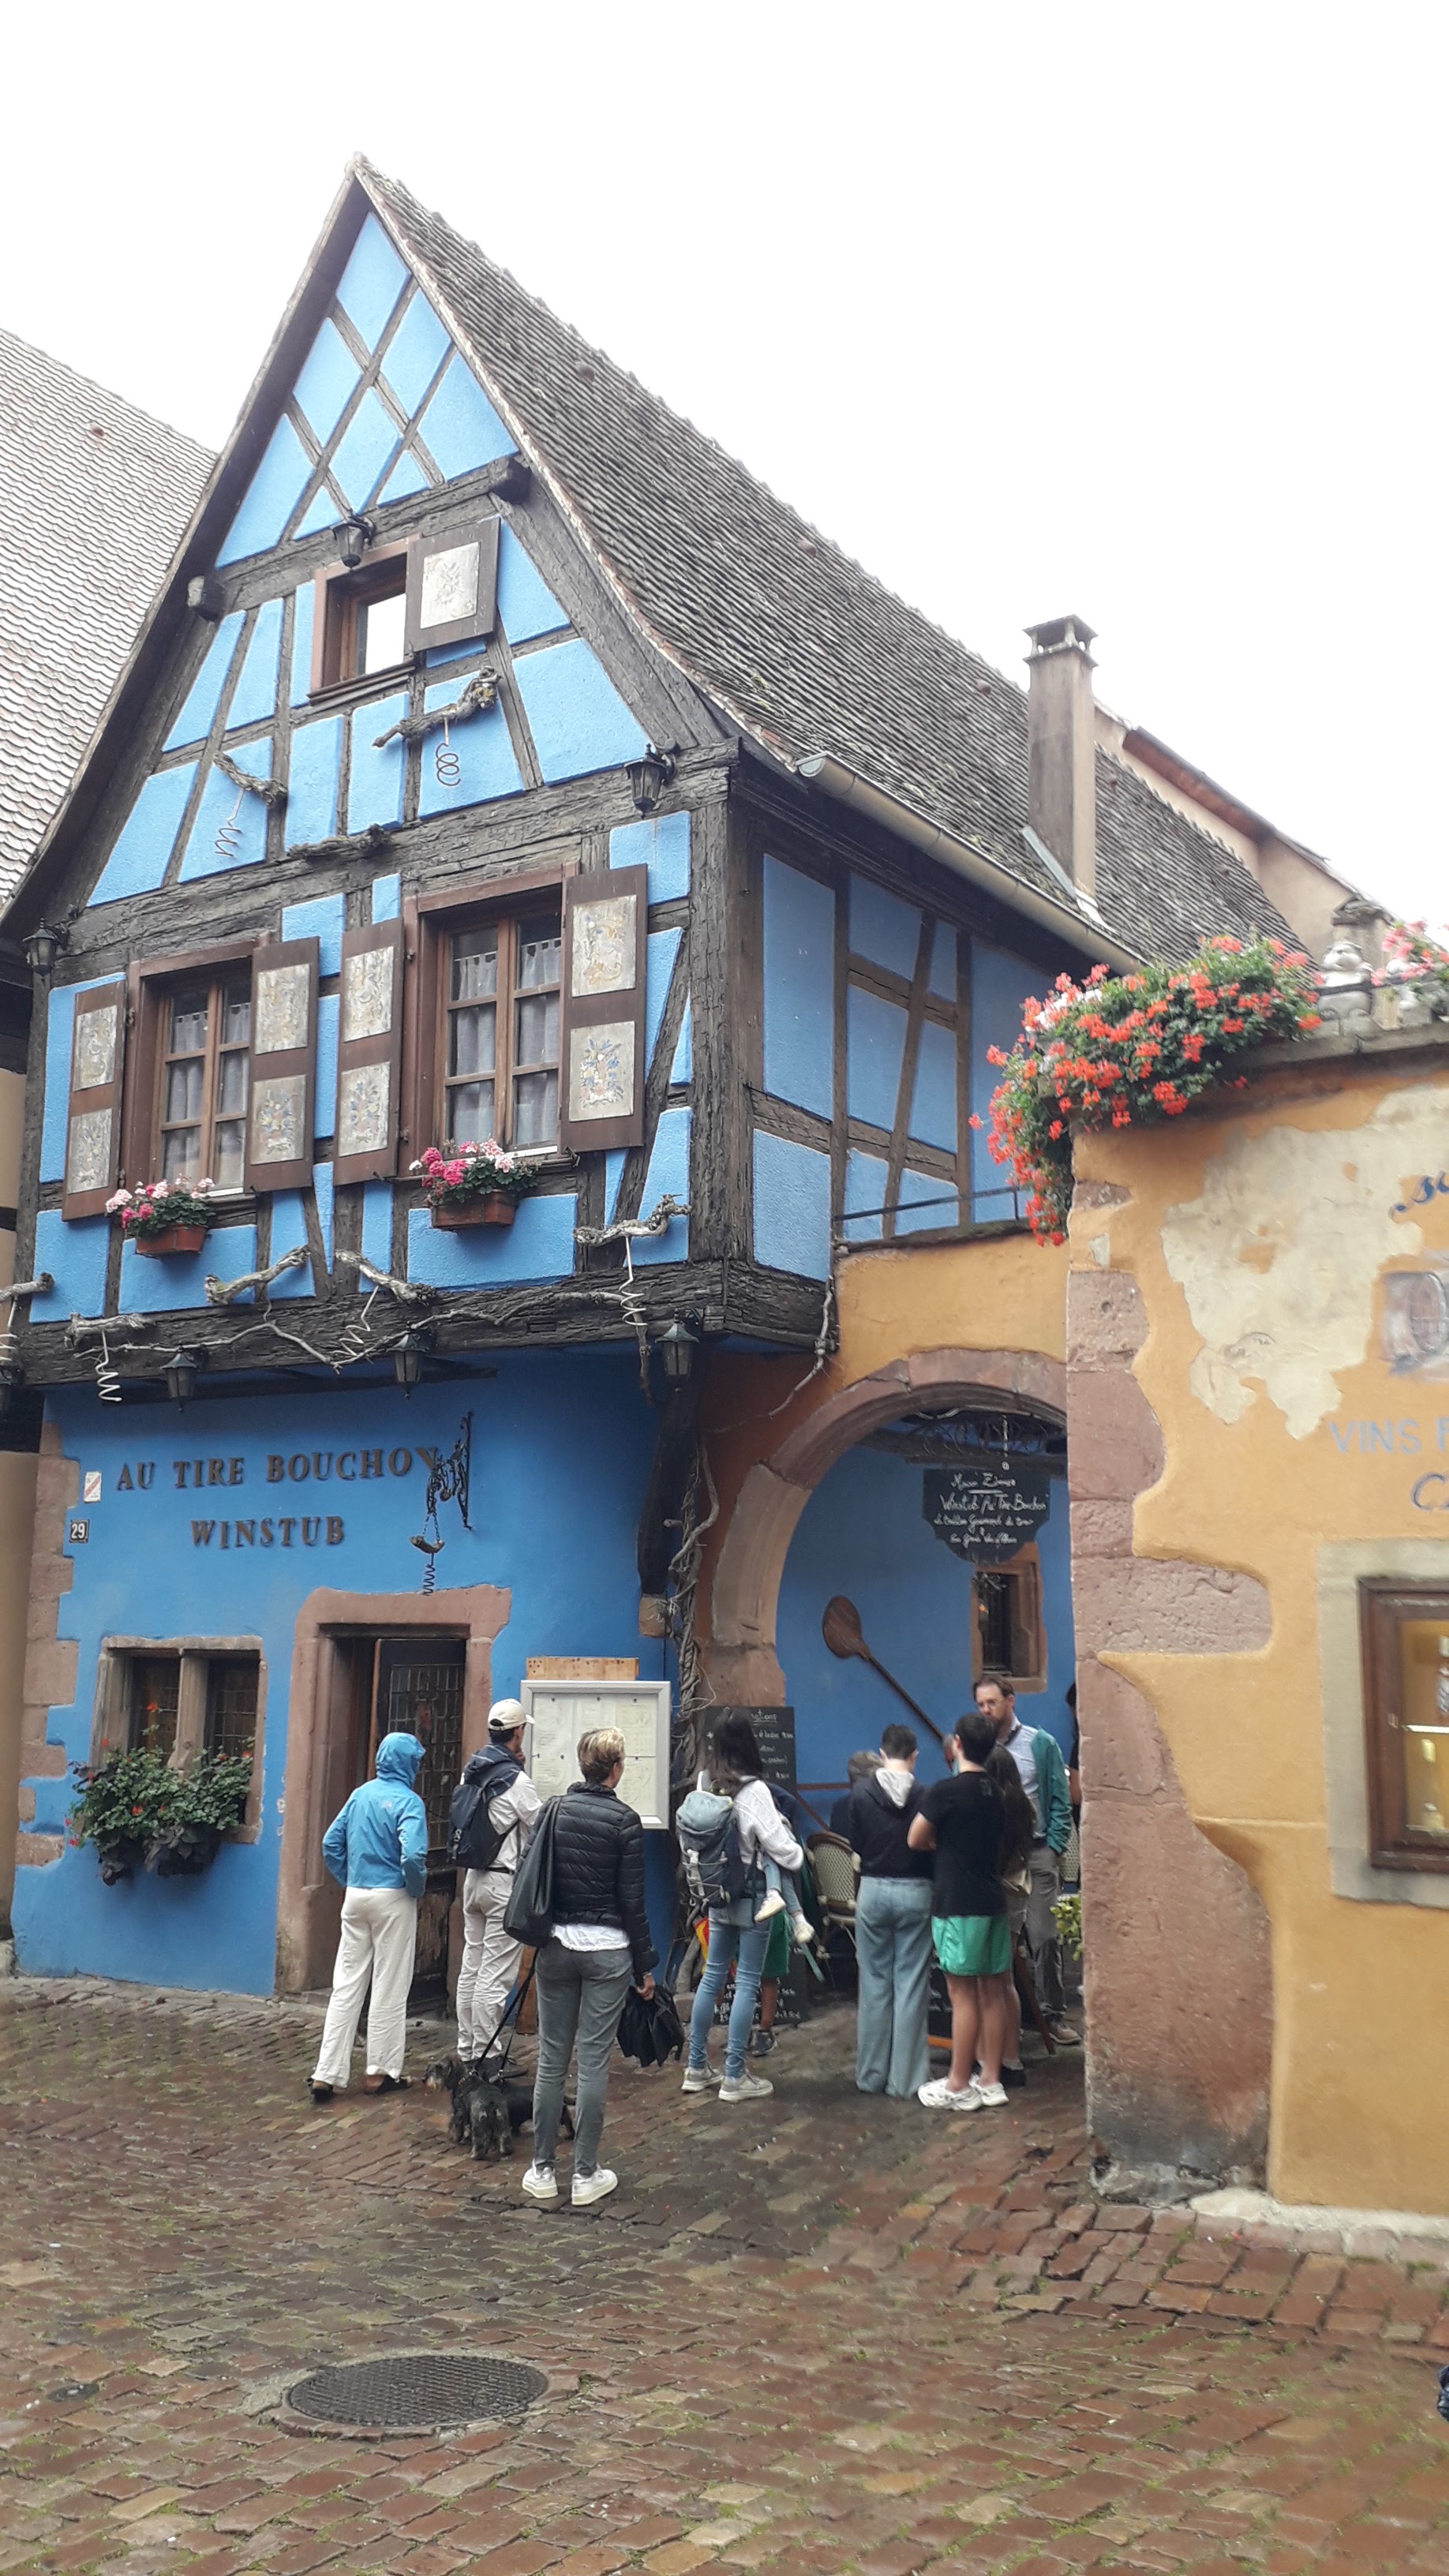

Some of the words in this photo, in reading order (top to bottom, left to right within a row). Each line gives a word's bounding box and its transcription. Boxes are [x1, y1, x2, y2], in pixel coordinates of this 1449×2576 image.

[1329, 1418, 1422, 1455] VINS
[117, 1462, 155, 1492] AU
[173, 1457, 245, 1489] TIRE
[71, 1523, 86, 1539] 29
[191, 1515, 345, 1550] WINSTUB
